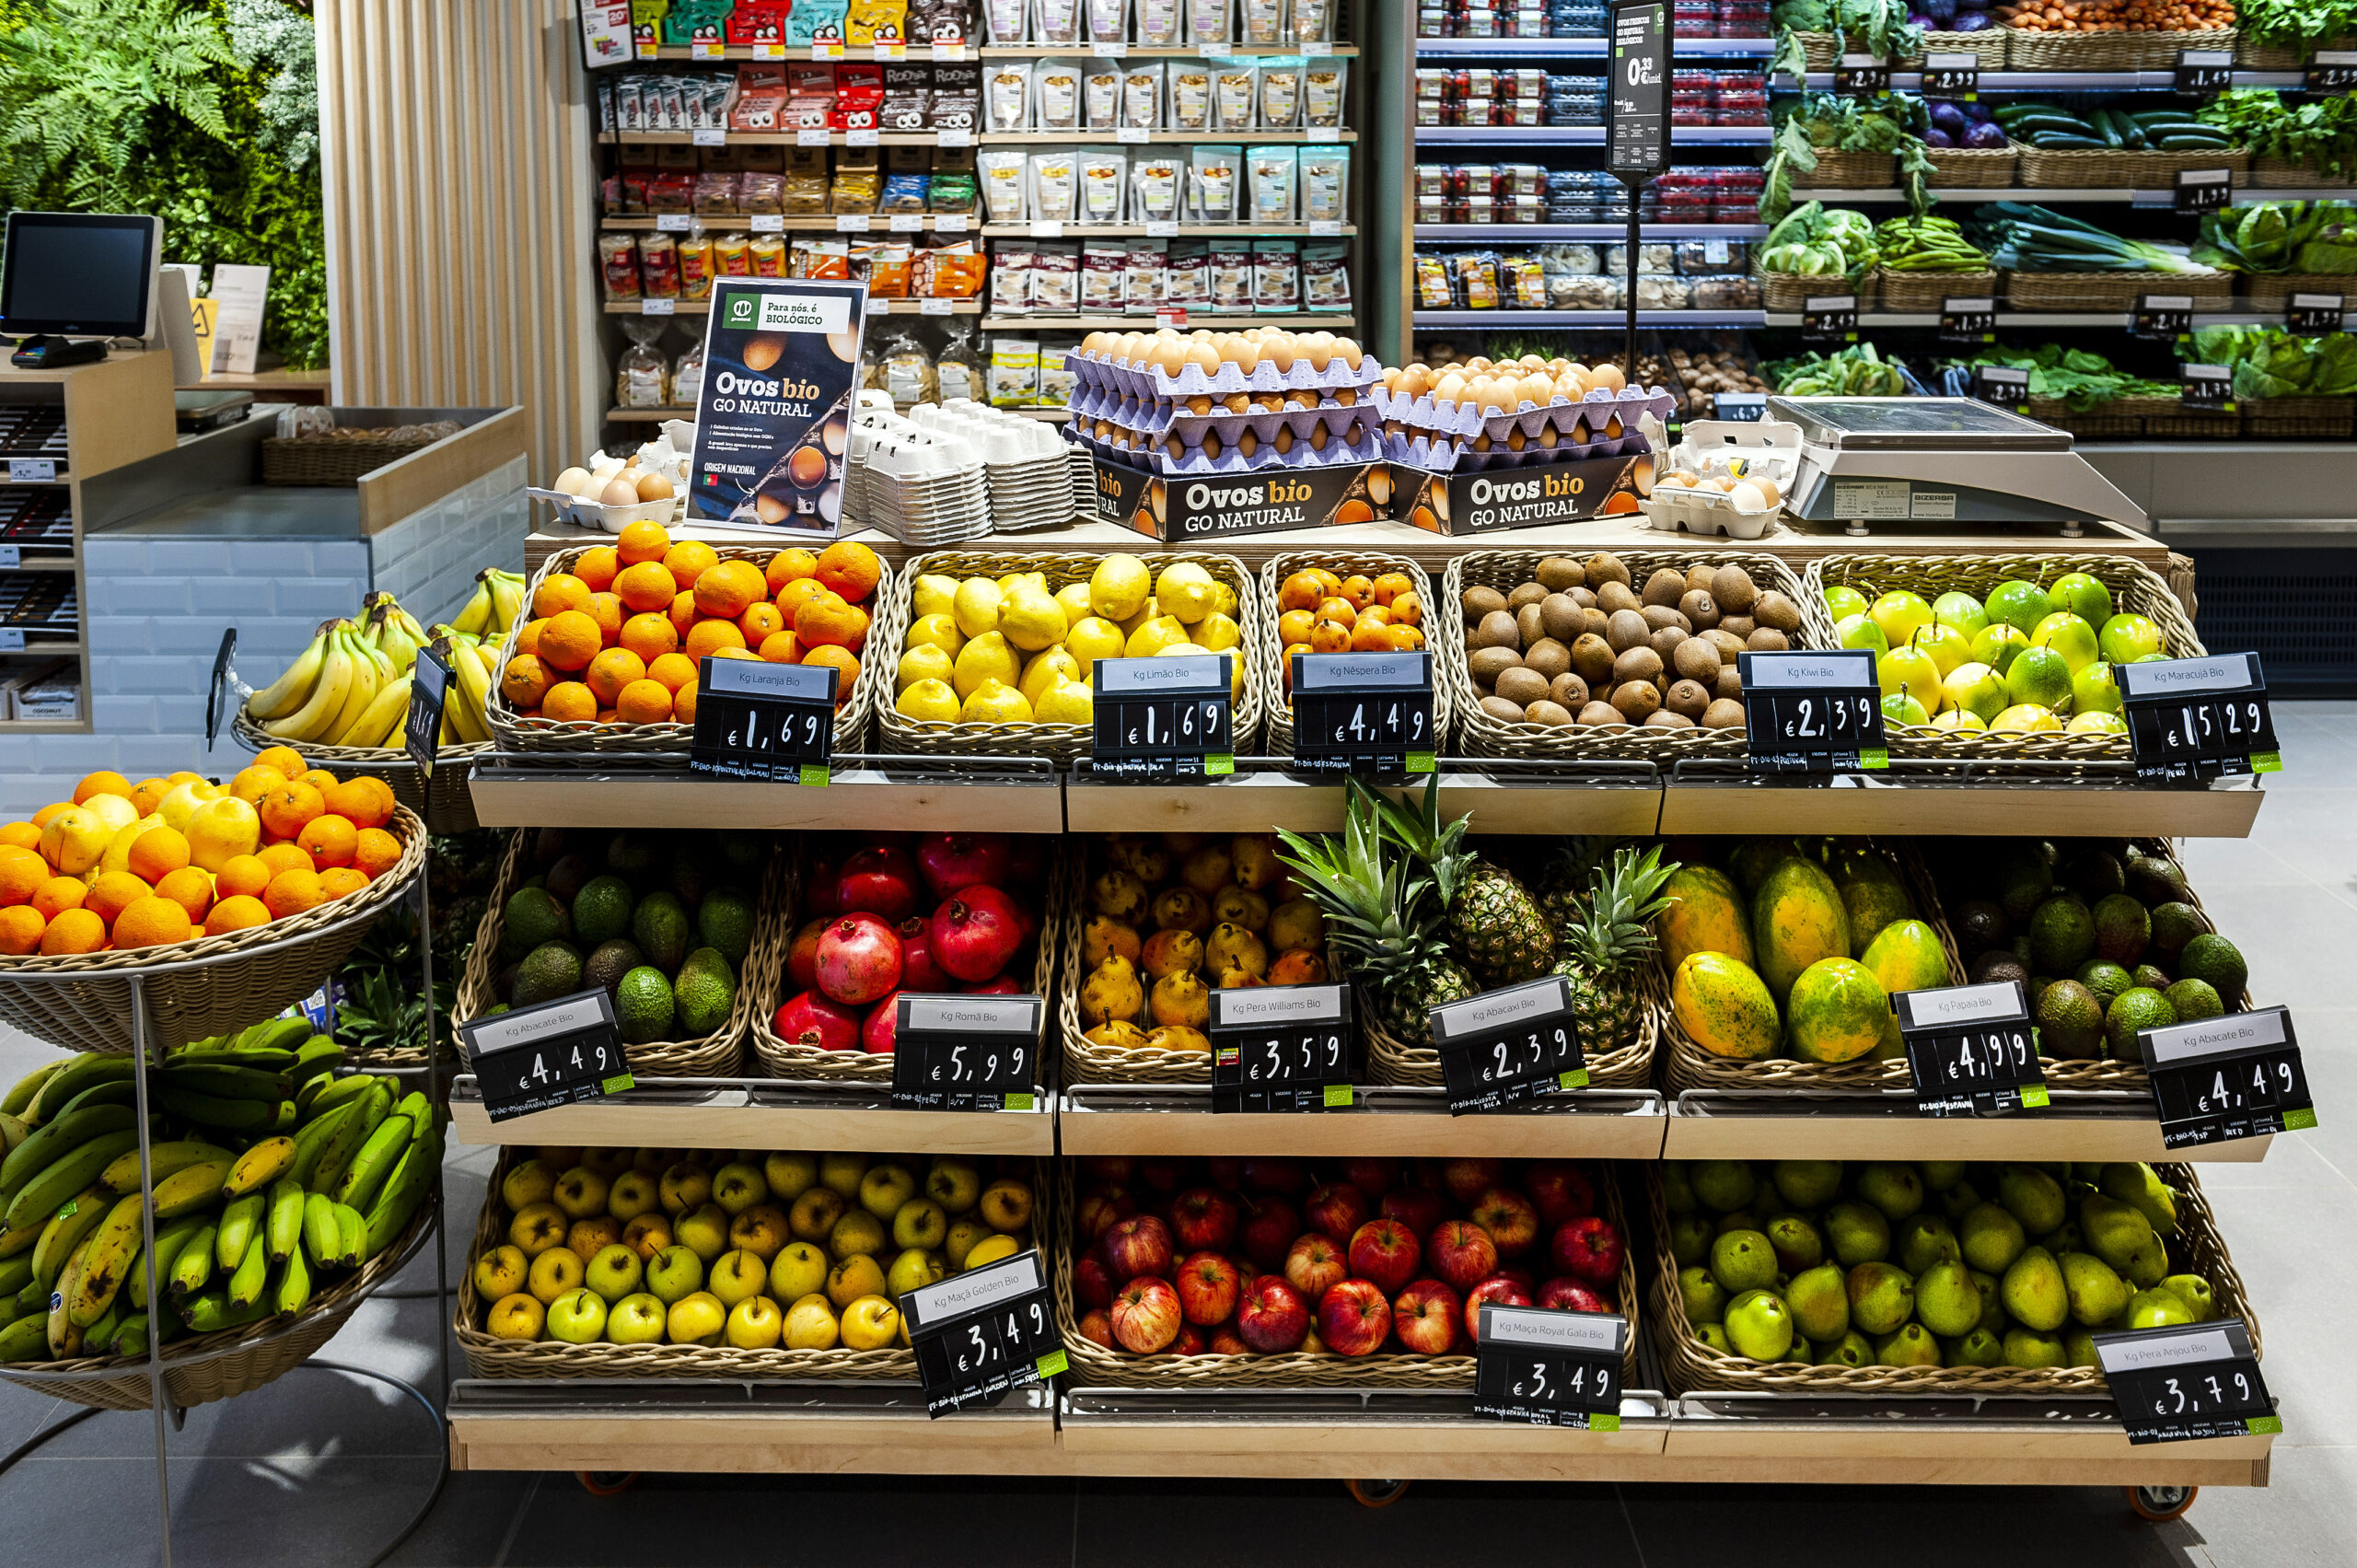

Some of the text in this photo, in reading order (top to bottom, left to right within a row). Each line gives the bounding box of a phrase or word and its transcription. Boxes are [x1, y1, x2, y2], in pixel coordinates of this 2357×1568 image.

[768, 302, 817, 313] Para nós, é
[765, 312, 822, 325] BIOLÓGICO
[716, 372, 819, 401] Ovos bio
[713, 399, 812, 417] GO NATURAL
[704, 462, 756, 475] ORIGEM NACIONAL
[1098, 469, 1122, 498] bio
[1470, 471, 1585, 505] Ovos bio
[1186, 478, 1312, 510] Ovos bio
[1185, 506, 1305, 532] GO NATURAL
[1469, 499, 1578, 527] GO NATURAL
[1133, 668, 1190, 681] Kg Limão Bio
[1329, 667, 1341, 676] Kg
[1382, 665, 1396, 675] Bio
[1788, 668, 1834, 678] Kg Kiwi Bio
[2154, 668, 2224, 682] Kg Maracujá Bio
[739, 673, 800, 687] Kg Laranja Bio
[1233, 999, 1321, 1015] Kg Pera Williams Bio
[1472, 999, 1536, 1022] Kg Abacaxi Bio
[1938, 997, 1992, 1013] Kg Papaia Bio
[505, 1013, 574, 1038] Kg Abacate Bio
[941, 1012, 953, 1022] Kg
[983, 1013, 998, 1022] Bio
[2183, 1028, 2254, 1047] Kg Abacate Bio
[934, 1274, 1019, 1308] Kg Maçã Golden Bio
[1499, 1321, 1512, 1333] Kg
[1539, 1326, 1565, 1337] Royal
[1567, 1328, 1587, 1339] Gala
[1589, 1330, 1604, 1340] Bio
[2124, 1344, 2208, 1363] Kg Pera Anjou Bio
